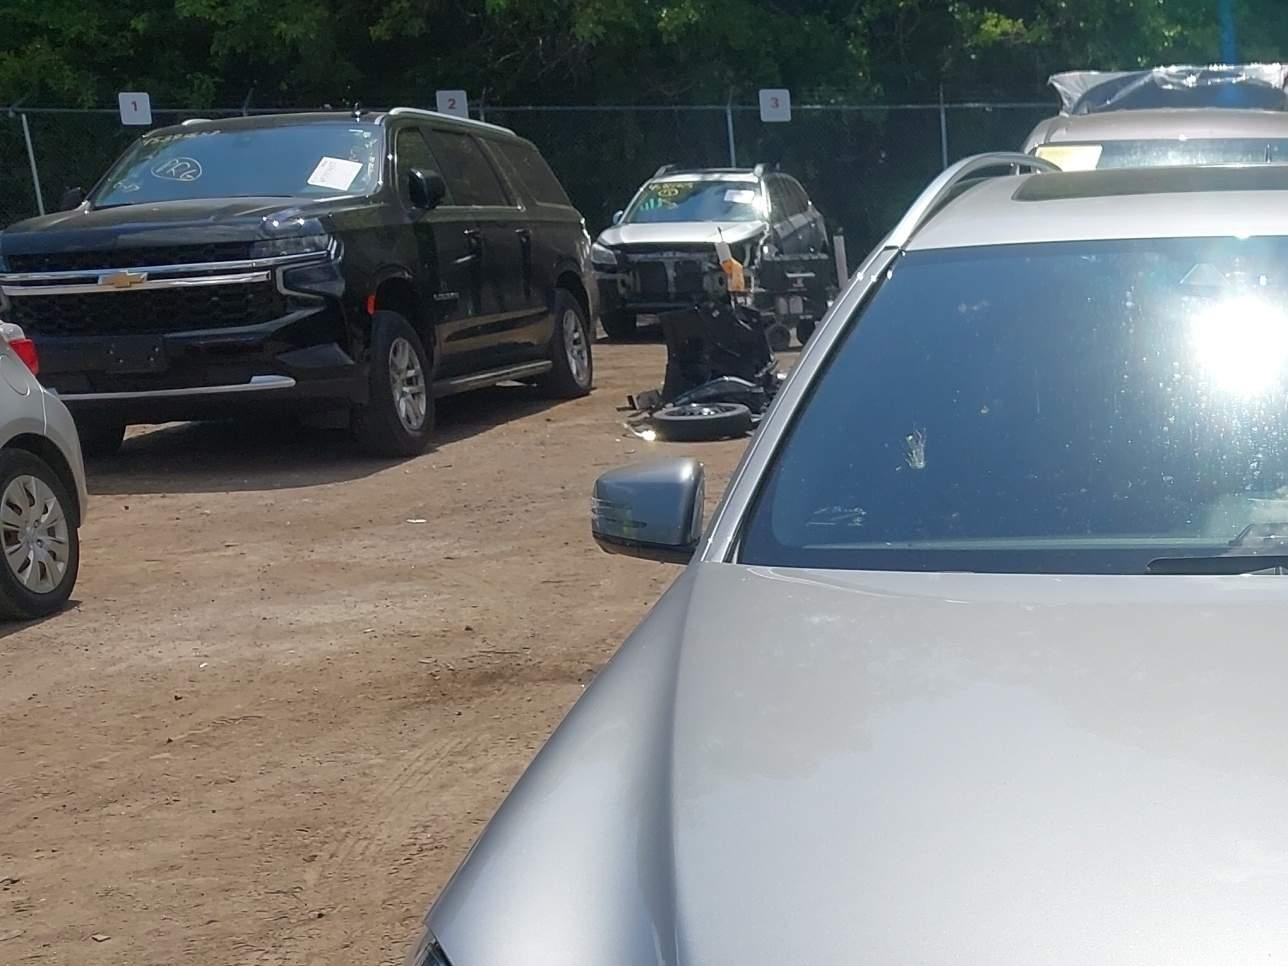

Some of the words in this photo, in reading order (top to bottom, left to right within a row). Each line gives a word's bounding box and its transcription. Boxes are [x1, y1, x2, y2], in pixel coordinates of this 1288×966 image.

[131, 101, 138, 112] 1
[447, 98, 457, 110] 2
[769, 96, 780, 109] 3
